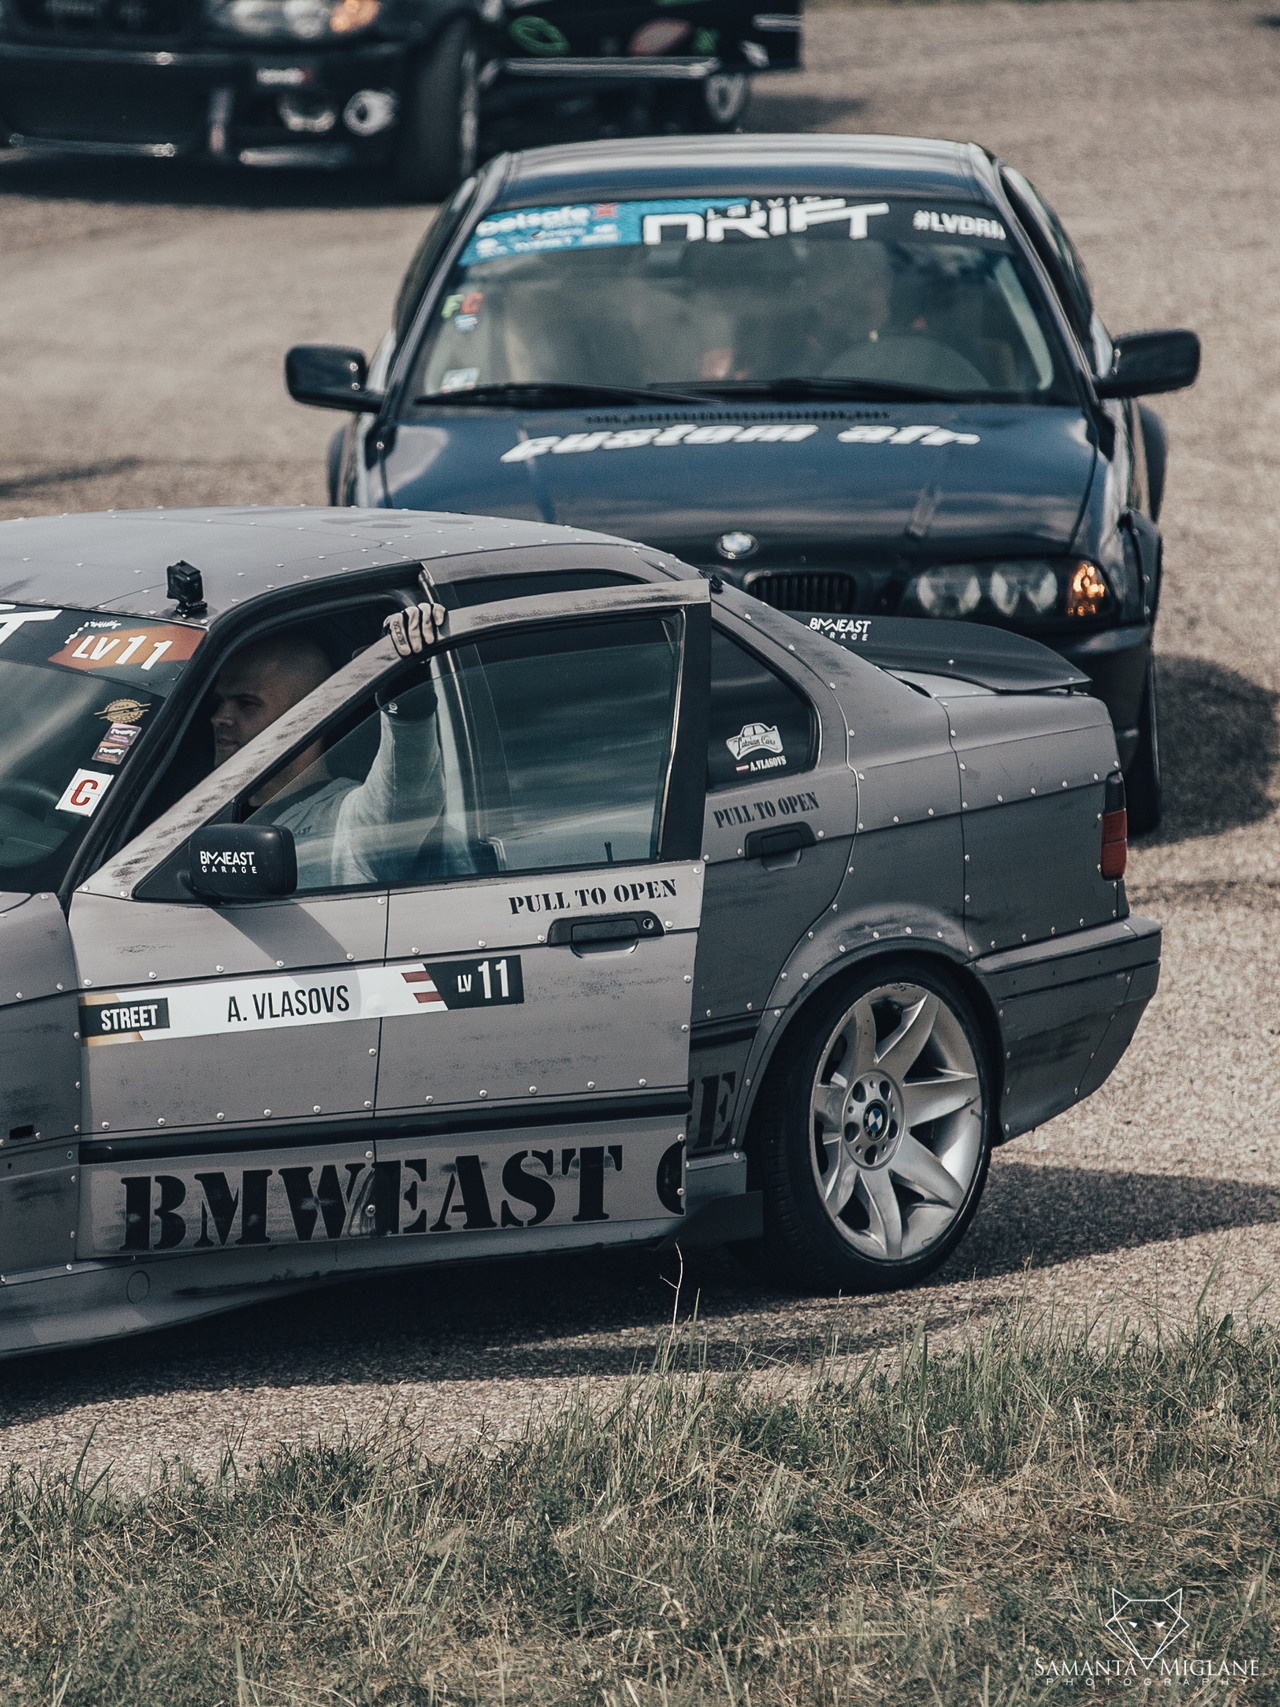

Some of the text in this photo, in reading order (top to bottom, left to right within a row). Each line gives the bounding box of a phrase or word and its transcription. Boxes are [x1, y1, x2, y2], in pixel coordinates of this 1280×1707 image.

[643, 198, 890, 246] DRIFT
[70, 779, 99, 807] C
[713, 791, 820, 828] PULL TO OPEN
[201, 866, 258, 874] GARAGE
[508, 879, 678, 915] PULL TO OPEN
[457, 959, 510, 999] LV 11
[100, 1004, 158, 1031] STREET
[227, 985, 350, 1022] A. VLASOVS
[120, 1144, 623, 1252] BMWEAST
